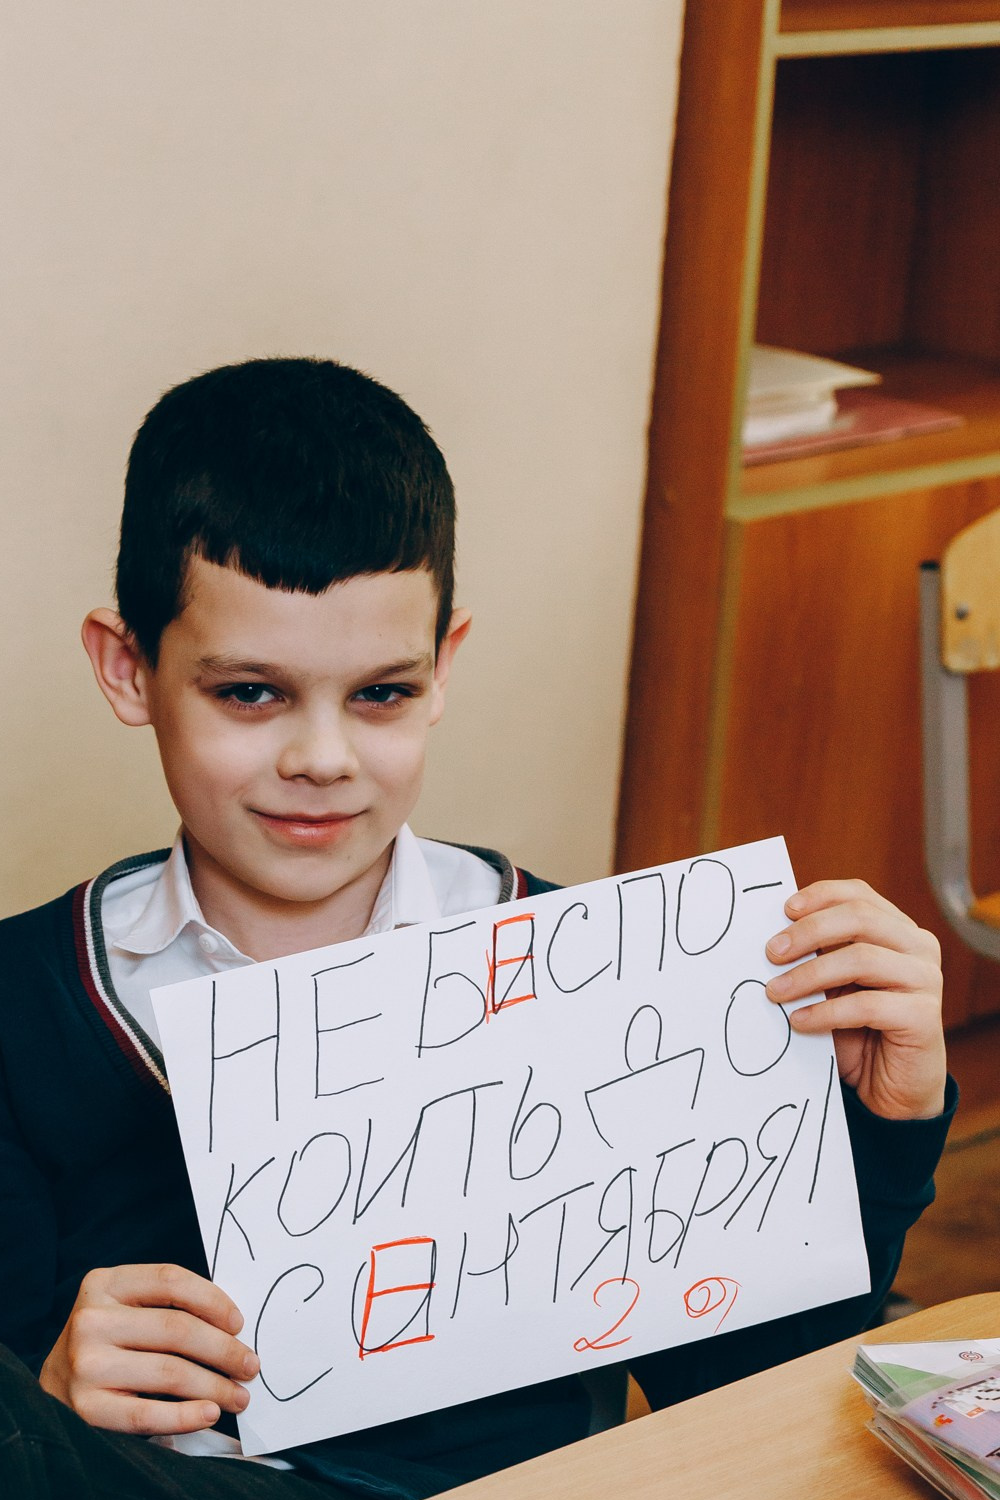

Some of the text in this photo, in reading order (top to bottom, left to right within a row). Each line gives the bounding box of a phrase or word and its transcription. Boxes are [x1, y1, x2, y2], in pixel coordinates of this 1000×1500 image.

[208, 951, 385, 1153] НЕ
[211, 979, 792, 1278] КОИТЬ ДО
